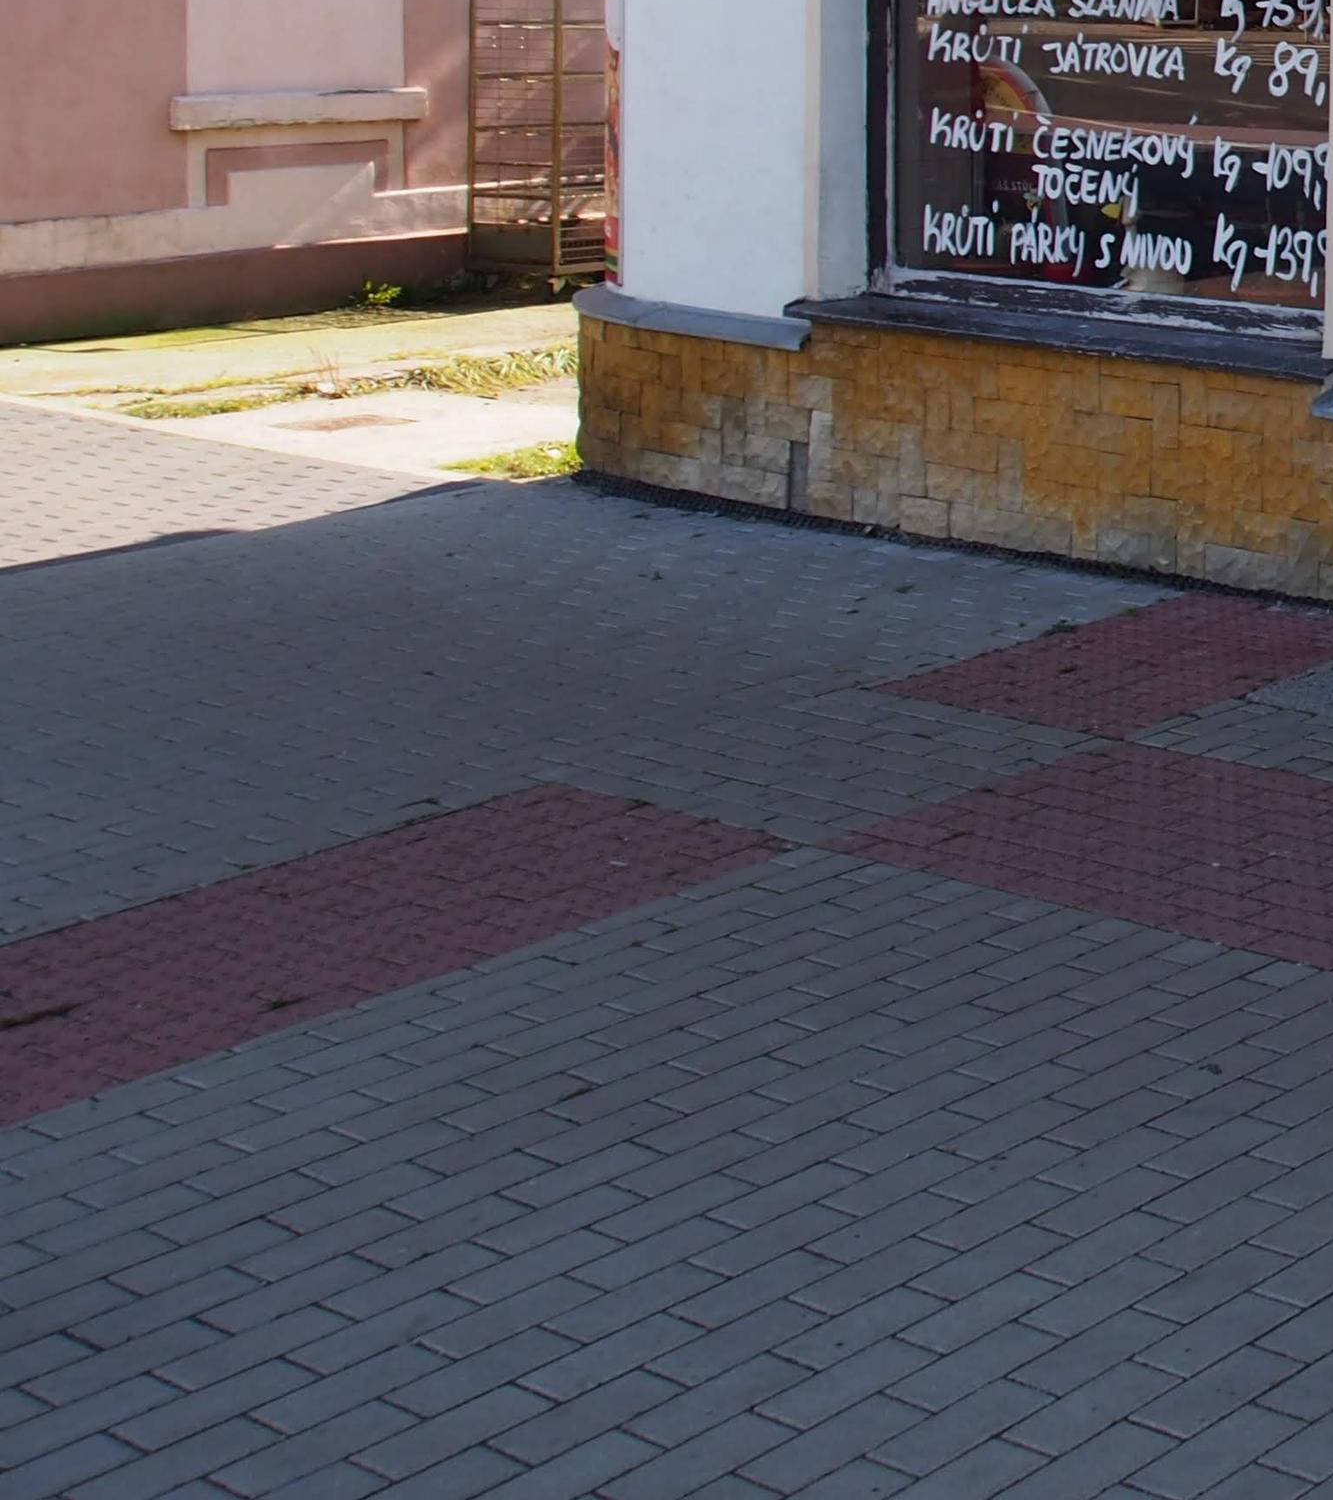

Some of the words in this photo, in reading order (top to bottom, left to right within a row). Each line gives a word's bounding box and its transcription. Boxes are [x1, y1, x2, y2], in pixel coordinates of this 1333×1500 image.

[1042, 32, 1186, 81] JÁTROVKA
[1094, 233, 1116, 269] S
[1120, 231, 1193, 276] NIVOU
